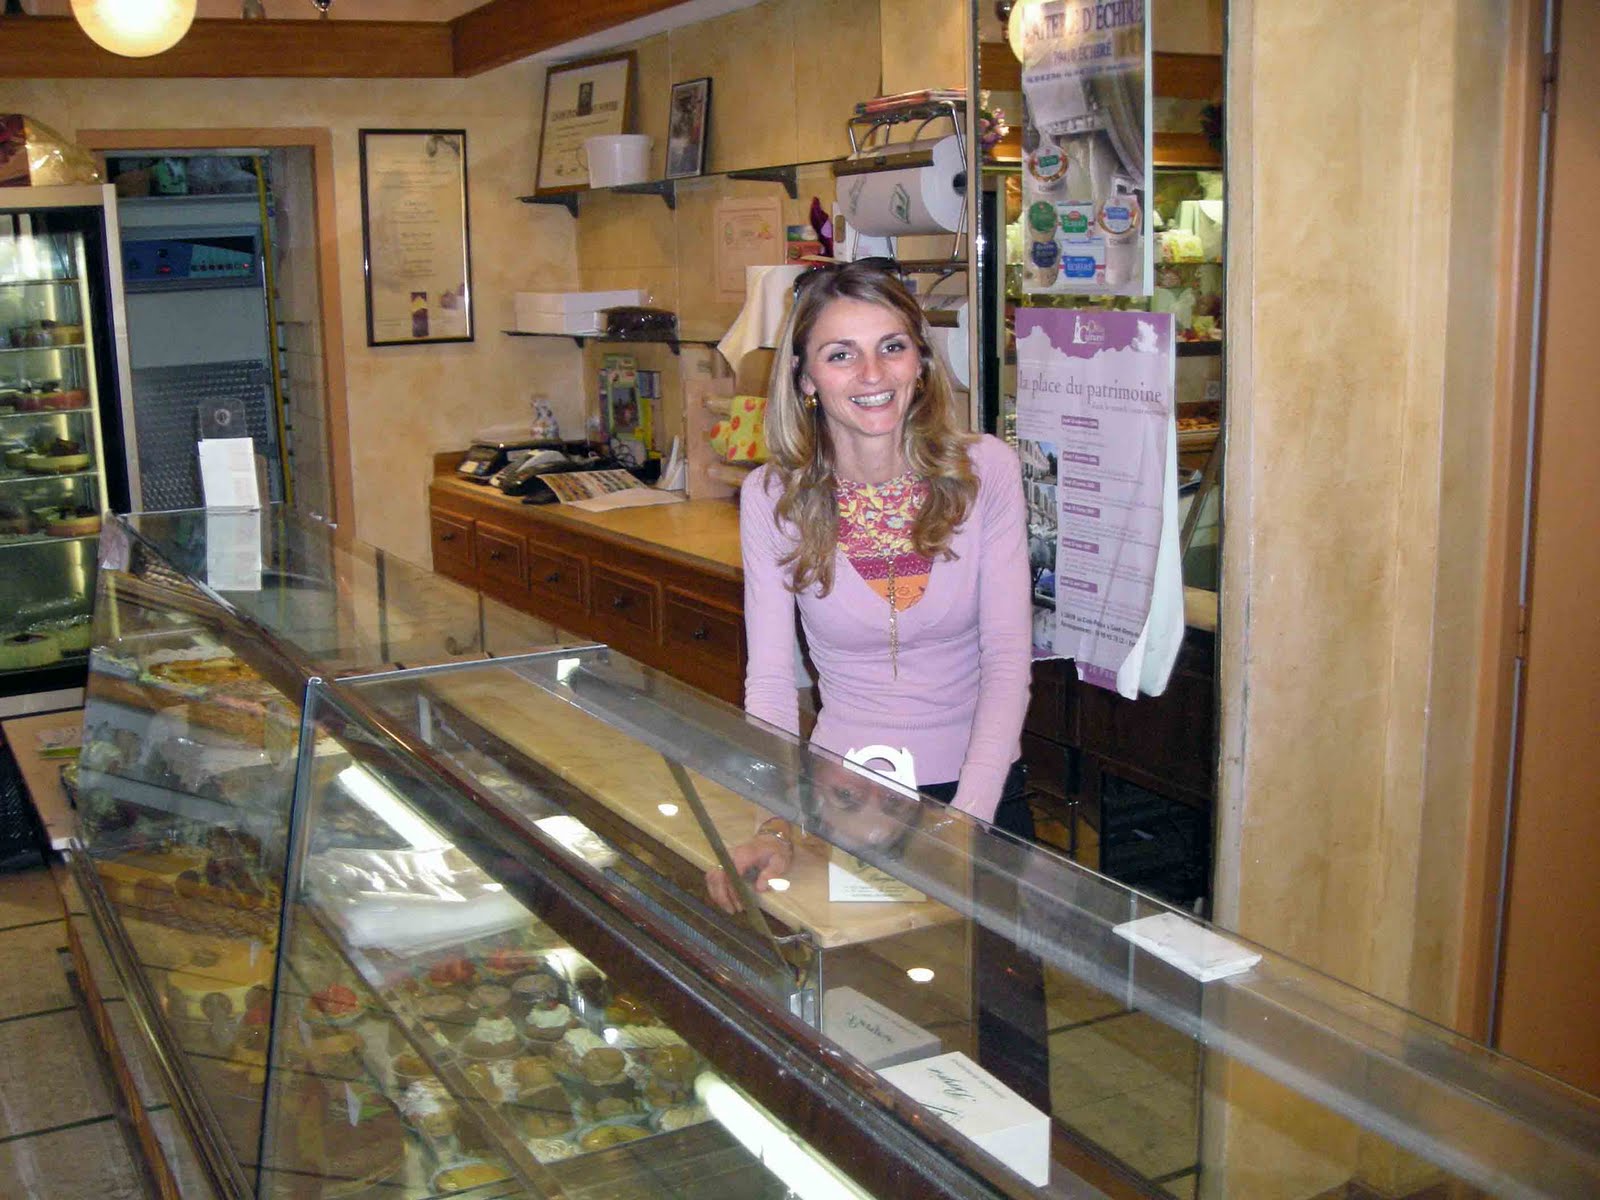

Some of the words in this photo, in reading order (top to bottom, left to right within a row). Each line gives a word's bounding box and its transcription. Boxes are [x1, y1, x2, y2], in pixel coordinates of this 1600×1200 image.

[1019, 370, 1029, 390] la
[1032, 372, 1062, 399] place
[1066, 376, 1083, 395] du
[1087, 378, 1162, 404] patrimoine
